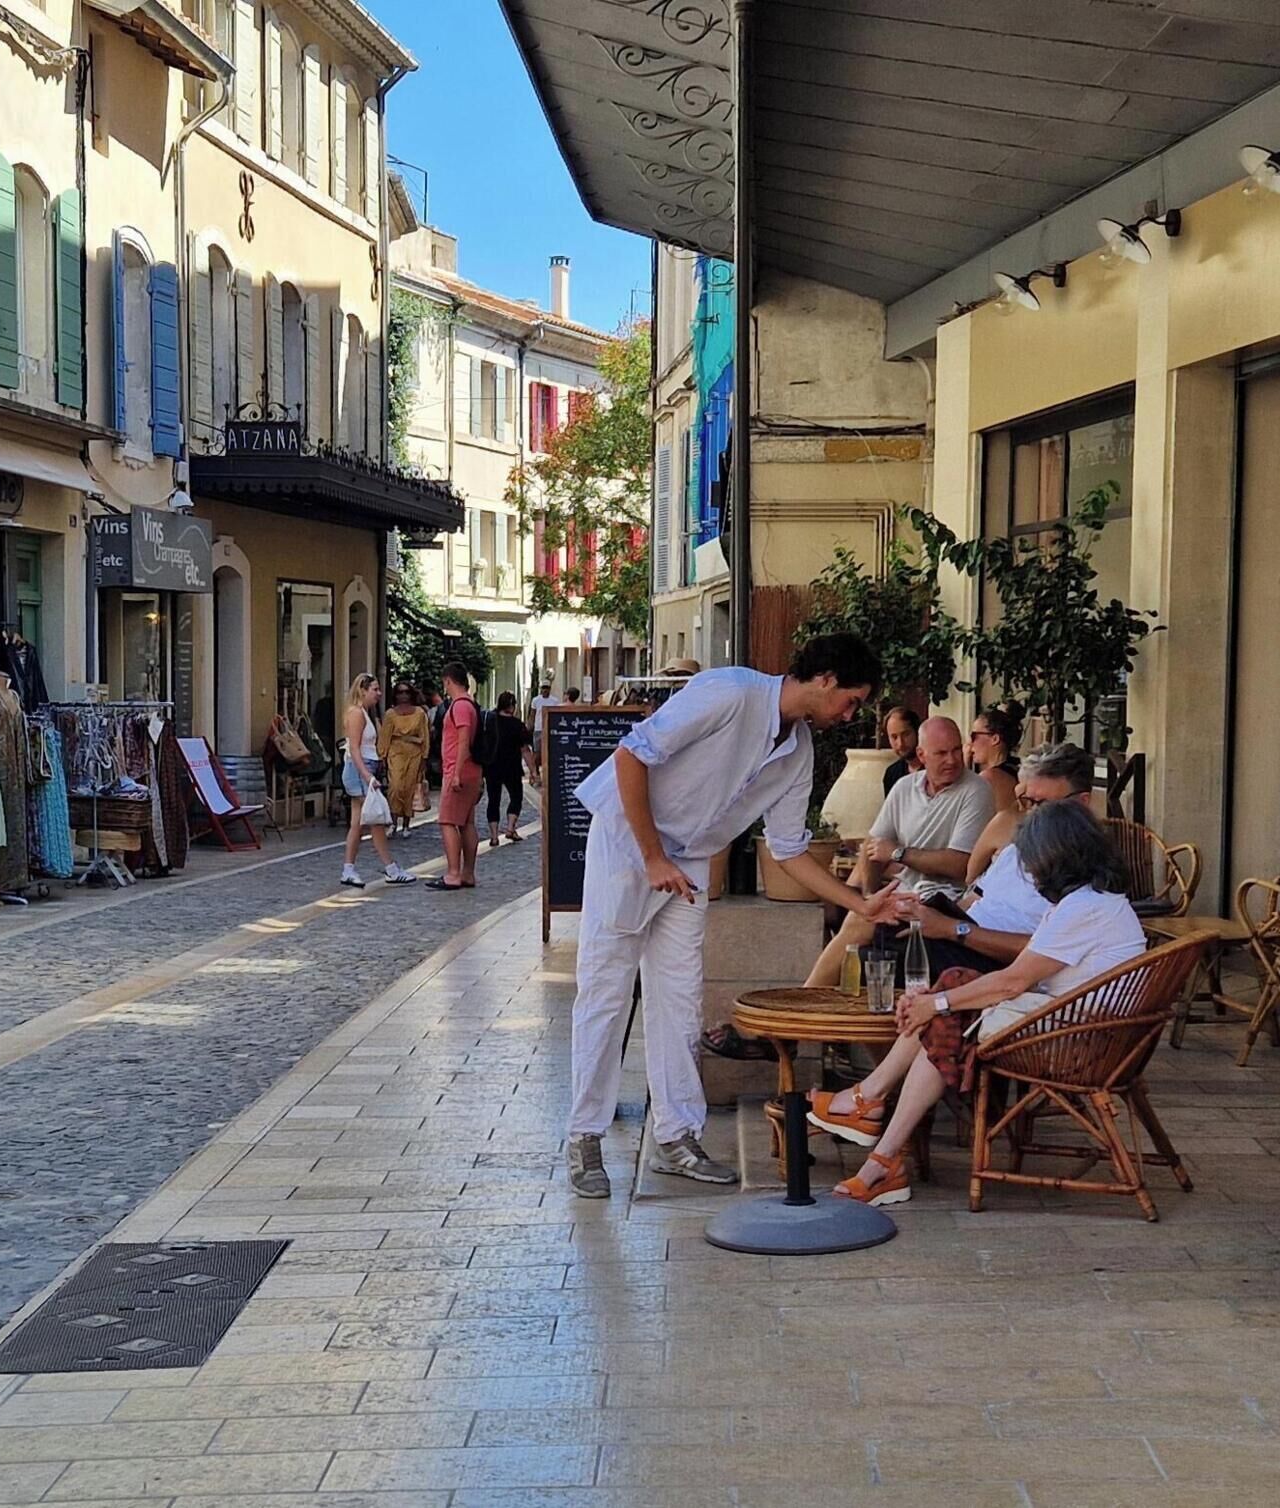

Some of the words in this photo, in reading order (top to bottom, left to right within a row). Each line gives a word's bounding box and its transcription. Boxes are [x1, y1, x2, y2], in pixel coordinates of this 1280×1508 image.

[228, 428, 298, 450] ATZANA
[93, 519, 129, 534] Vins
[141, 511, 164, 543] Vins
[102, 554, 124, 567] etc
